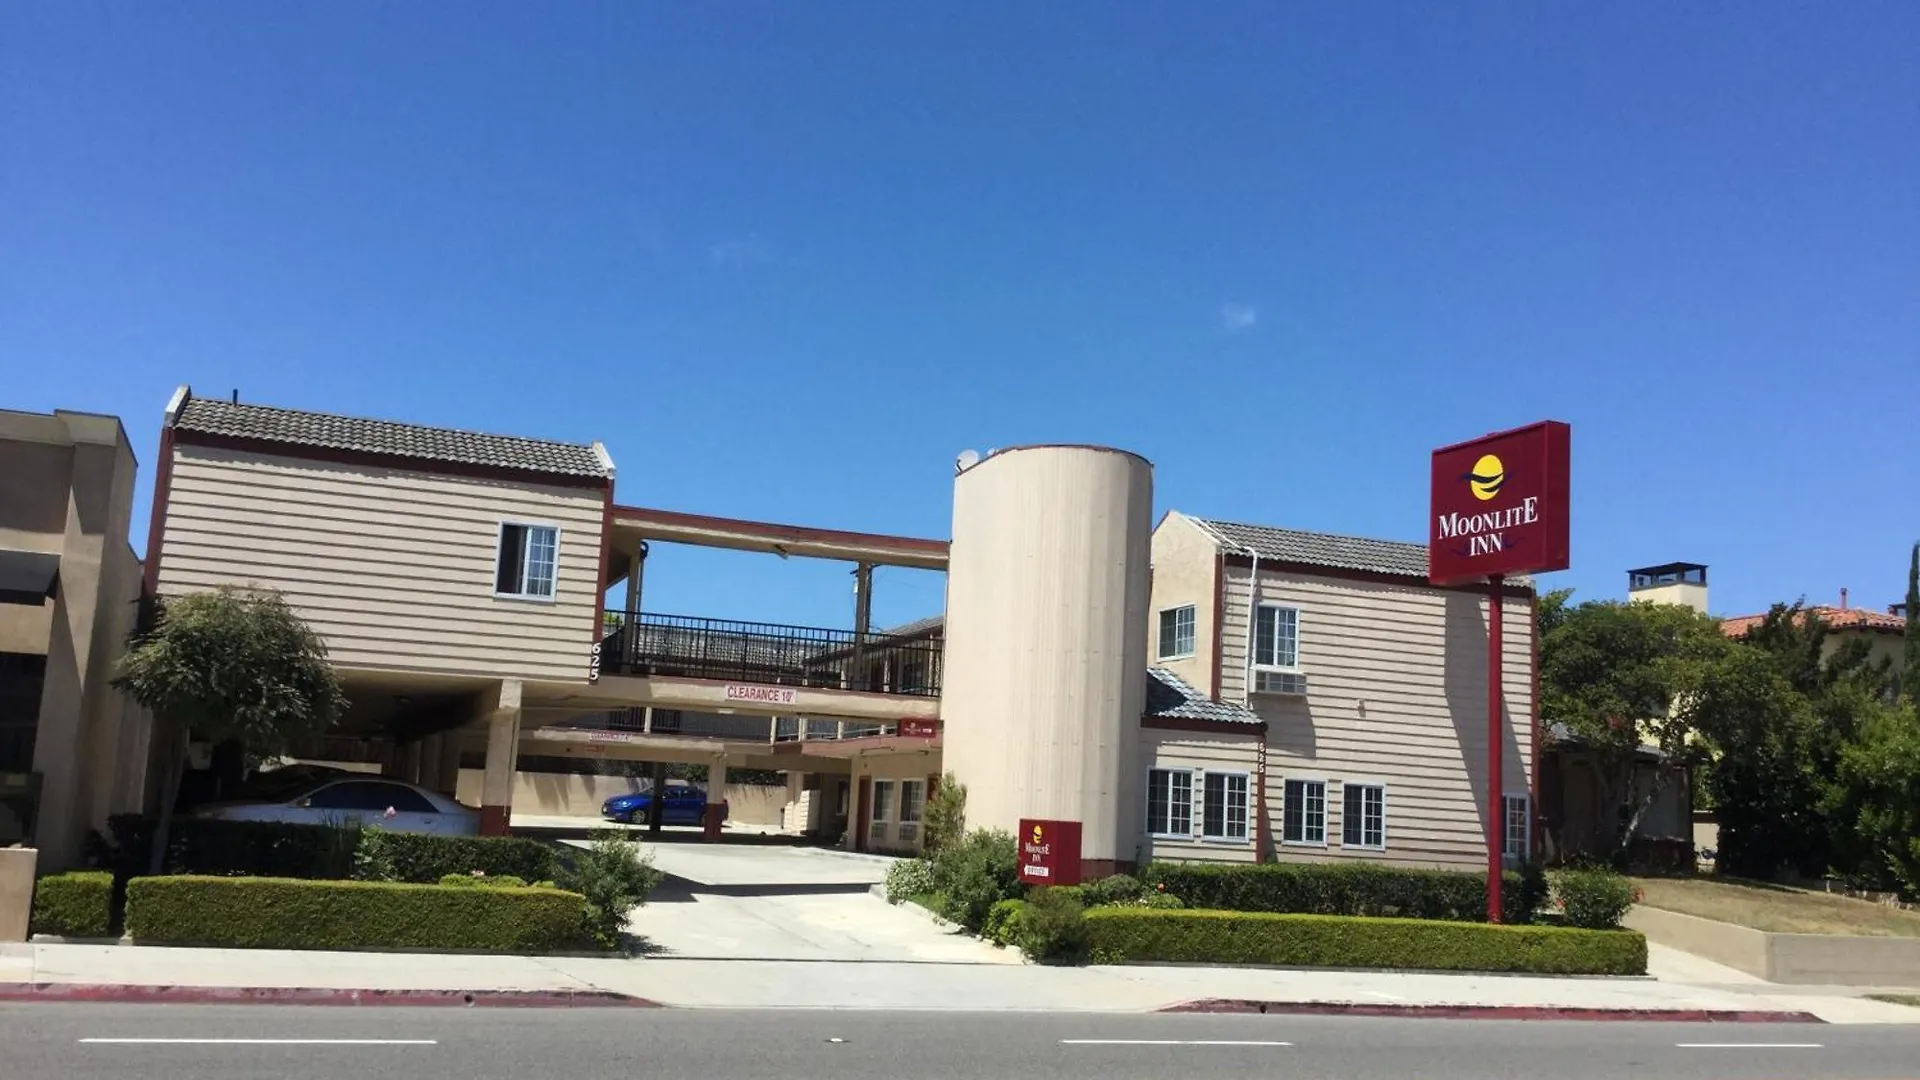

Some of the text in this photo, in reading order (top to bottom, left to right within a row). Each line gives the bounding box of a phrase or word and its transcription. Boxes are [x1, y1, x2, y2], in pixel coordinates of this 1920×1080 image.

[1438, 496, 1538, 539] MOONLITE
[1470, 532, 1503, 556] INN
[591, 642, 601, 680] 625
[728, 686, 780, 701] CLEARANCE
